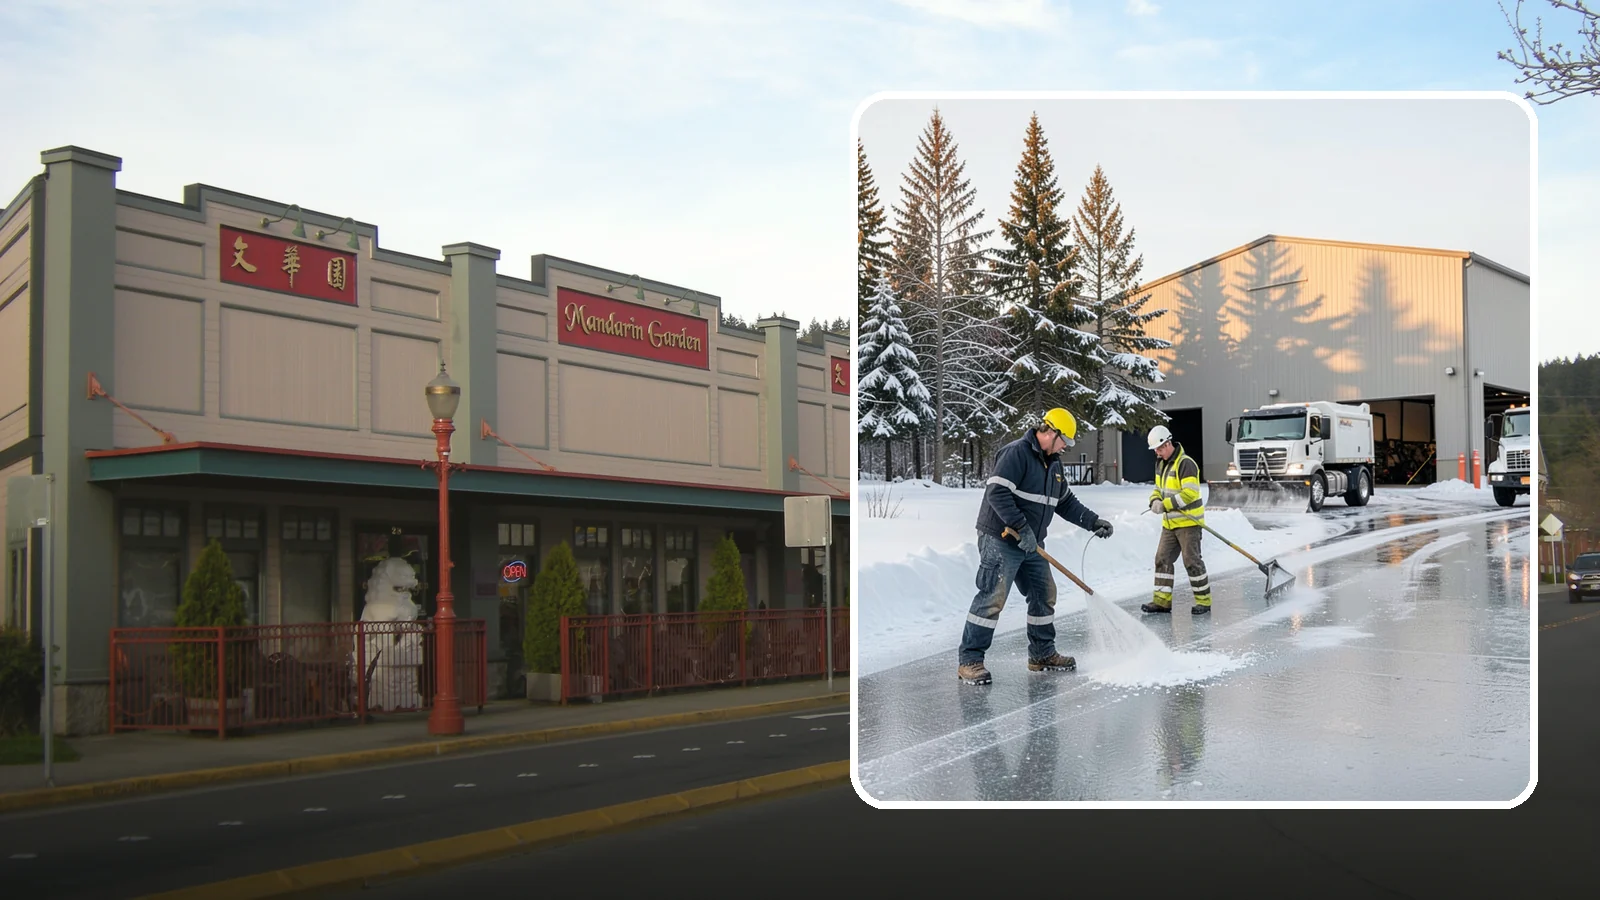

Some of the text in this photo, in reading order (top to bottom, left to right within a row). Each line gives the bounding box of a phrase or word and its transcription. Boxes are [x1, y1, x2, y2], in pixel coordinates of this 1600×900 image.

[231, 235, 346, 291] 文華園
[564, 302, 702, 352] Mandarin Garden
[503, 565, 527, 578] OPEN
